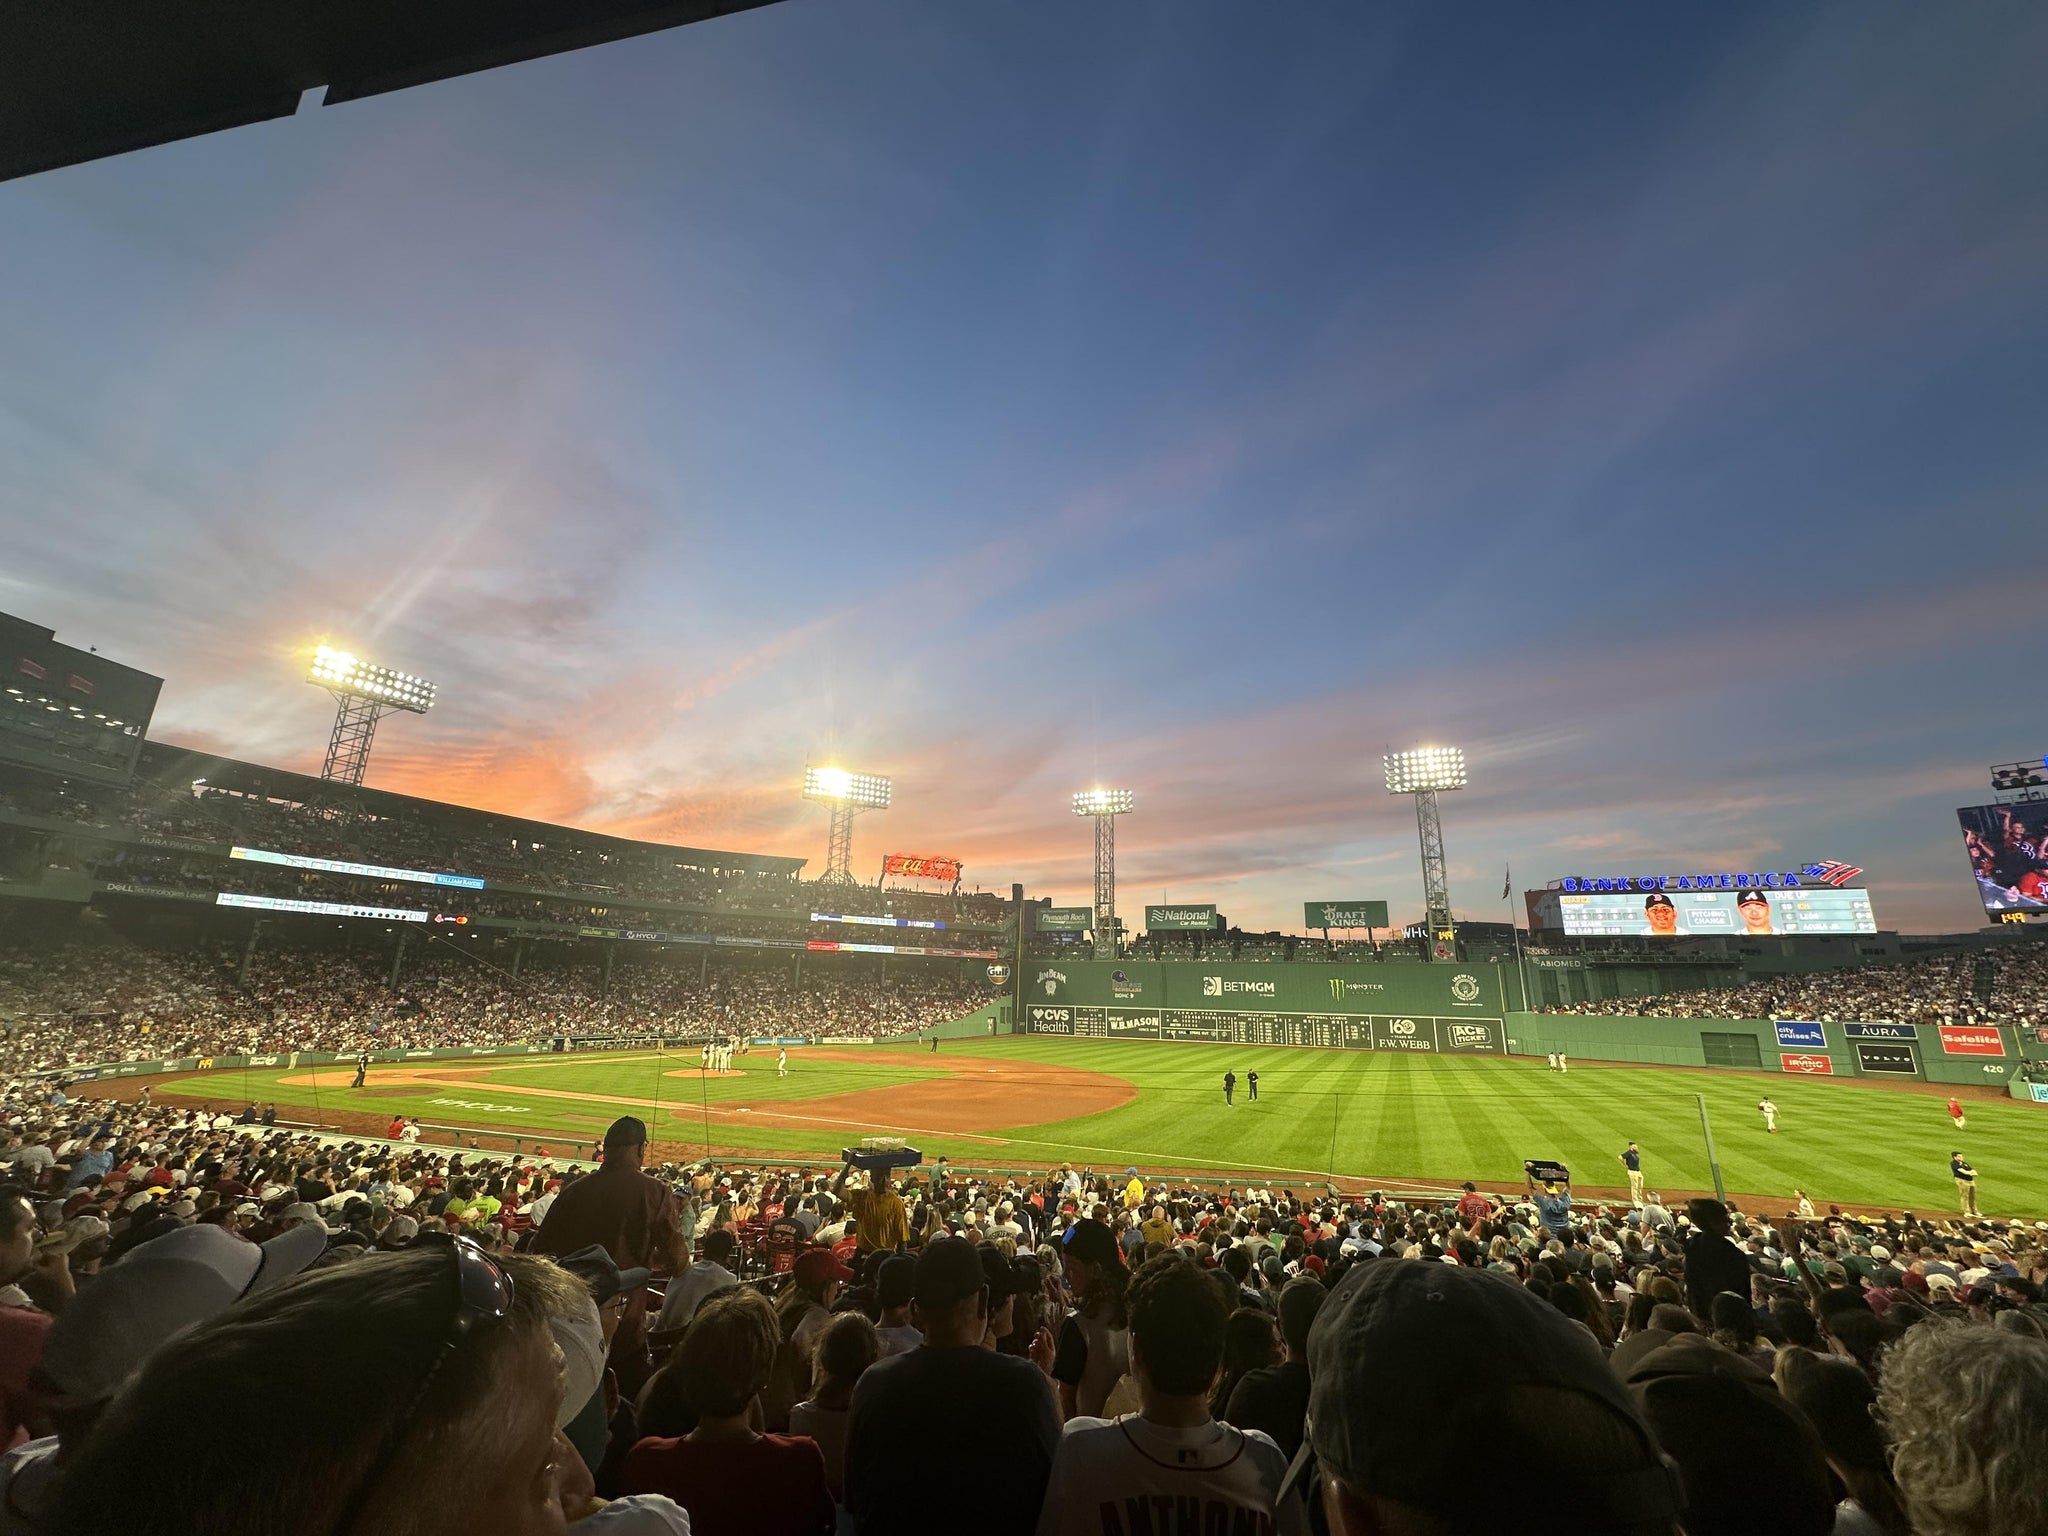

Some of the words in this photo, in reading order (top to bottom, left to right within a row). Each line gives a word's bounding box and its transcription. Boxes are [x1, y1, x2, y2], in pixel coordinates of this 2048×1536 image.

[140, 837, 168, 847] AURA
[1564, 876, 1632, 892] BANK
[1637, 875, 1669, 890] OF
[1678, 872, 1800, 889] AMERICA
[107, 883, 134, 892] DELL
[134, 886, 185, 897] Technologies
[186, 891, 206, 899] Level
[1042, 913, 1070, 922] Plymouth
[1070, 913, 1086, 921] Rock
[1164, 910, 1210, 921] National
[1324, 911, 1367, 921] DRAFT
[1330, 919, 1366, 927] KINGS
[988, 967, 1009, 977] Gulf
[1037, 971, 1049, 984] JIM
[1049, 968, 1067, 984] BEAM
[1223, 982, 1275, 992] BETMGM
[1044, 1009, 1070, 1021] CVS
[1034, 1020, 1070, 1033] Health
[1389, 1019, 1416, 1034] 160
[1455, 1025, 1486, 1036] ACE
[1861, 1028, 1900, 1036] AURA
[1457, 1035, 1486, 1043] TICKET
[1942, 1034, 2000, 1044] Safelite
[1379, 1039, 1398, 1048] F.W.
[1400, 1040, 1430, 1050] WEBB
[1789, 1059, 1824, 1068] IRVING
[1982, 1064, 2004, 1073] 420
[425, 1098, 531, 1113] WHOOP
[1466, 1206, 1486, 1217] 20
[780, 1262, 789, 1270] 17
